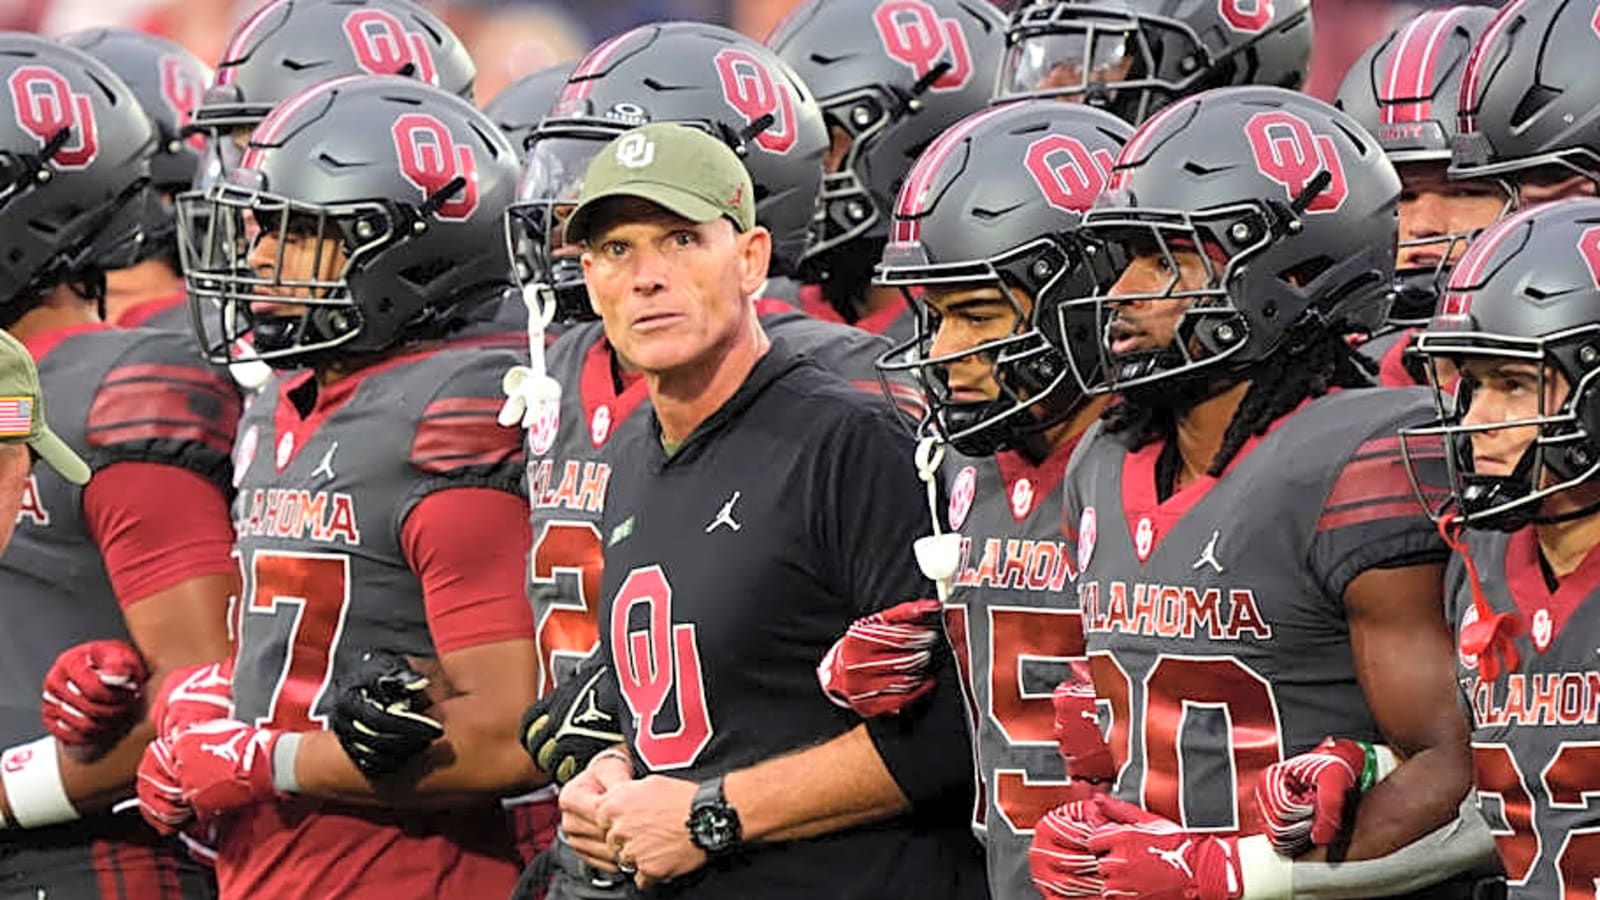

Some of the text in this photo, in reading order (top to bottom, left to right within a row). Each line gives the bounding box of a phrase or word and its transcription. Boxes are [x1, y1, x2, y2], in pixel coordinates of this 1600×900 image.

[870, 0, 975, 92] OU
[10, 66, 98, 171] OU
[616, 133, 656, 169] OU
[714, 48, 798, 155] OU
[391, 113, 479, 222] OU
[1245, 111, 1349, 214] OU
[227, 547, 350, 731] 7
[611, 564, 714, 772] OU
[943, 603, 1089, 835] 15
